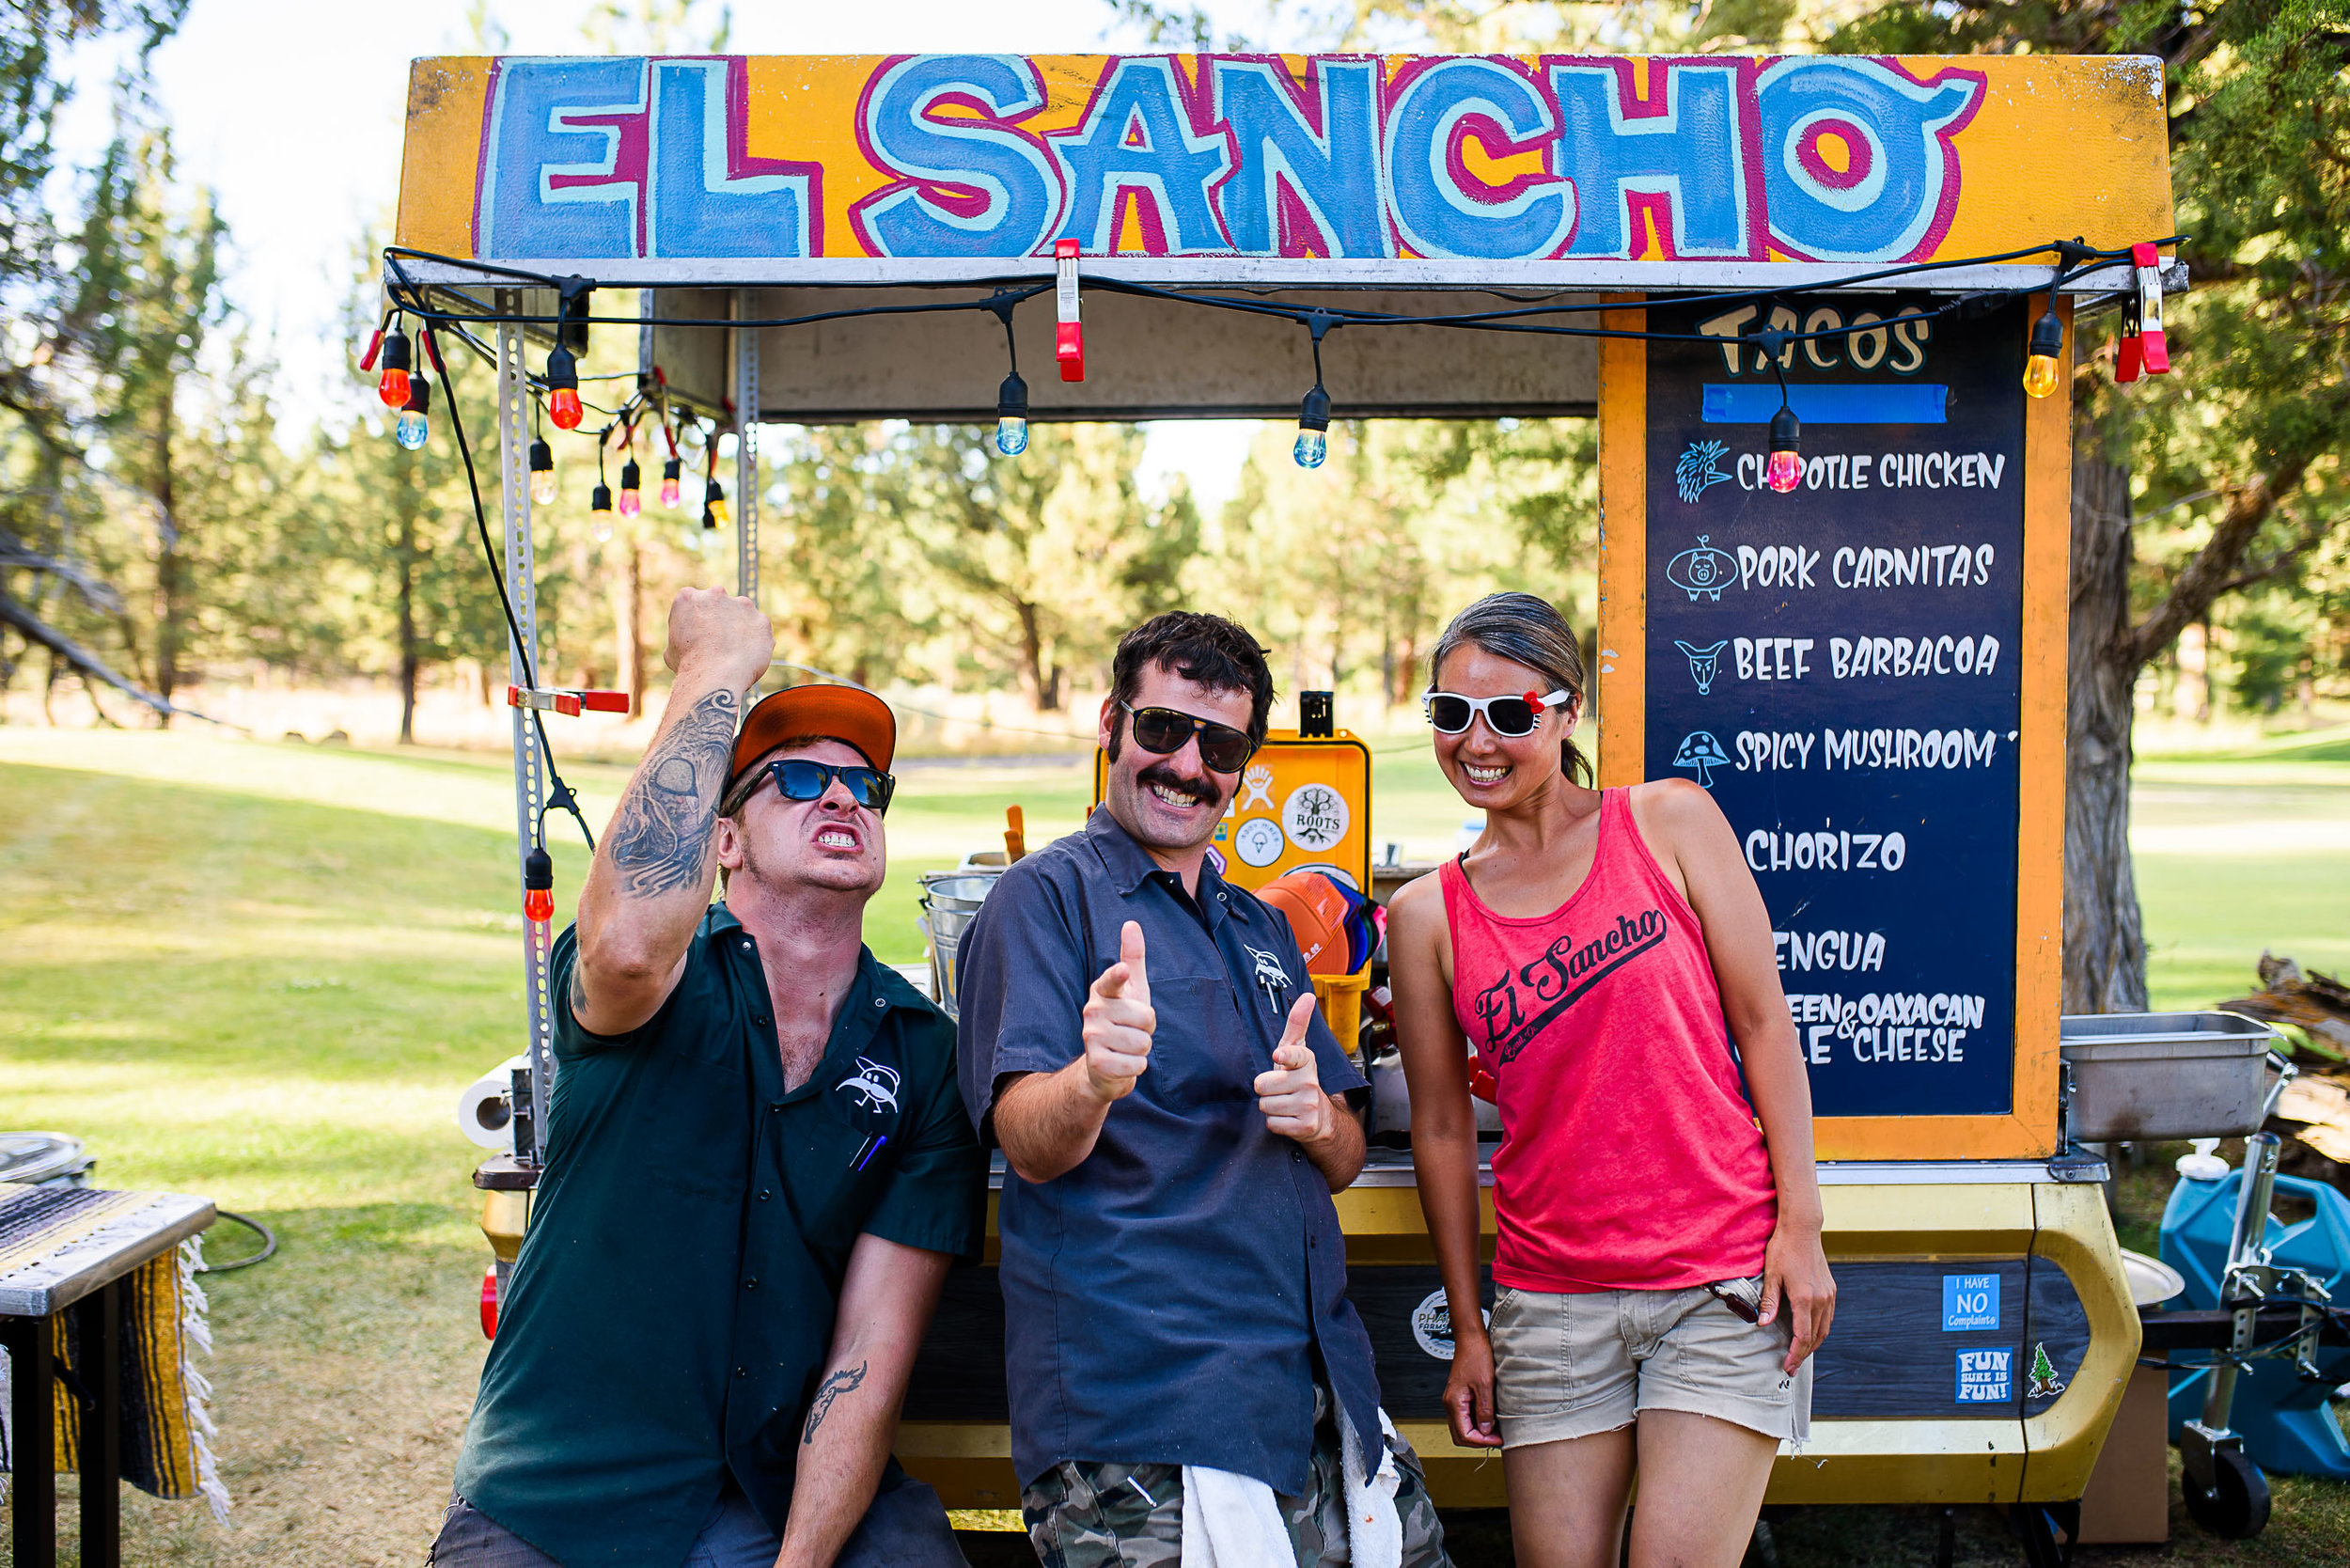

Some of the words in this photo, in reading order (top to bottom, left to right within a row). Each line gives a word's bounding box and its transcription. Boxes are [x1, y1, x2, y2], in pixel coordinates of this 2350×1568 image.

[474, 55, 823, 259] EL
[848, 54, 1987, 262] SANCHO
[1699, 303, 1930, 374] TACOS
[1736, 453, 1872, 491] CHOTLE
[1879, 451, 2006, 489] CHICKEN
[1737, 544, 1821, 590] PORK
[1832, 543, 1995, 588] CARNITAS
[1733, 636, 1814, 681] BEEF
[1829, 634, 2000, 679] BARBACOA
[1735, 730, 1815, 772] SPICY
[1825, 728, 1997, 770] MUSHROOM
[1296, 814, 1340, 830] ROOTS
[1746, 828, 1906, 871] CHORIZO
[1771, 930, 1887, 972] ENGUA
[1474, 969, 1526, 1053] El
[1520, 909, 1662, 1002] Sancho
[1784, 993, 1842, 1024] EEN
[1836, 1000, 1859, 1040] &
[1857, 992, 1985, 1029] OAXACAN
[1853, 1026, 1966, 1063] CHEESE
[1955, 1278, 1960, 1289] I
[1964, 1278, 1990, 1289] HAVE
[1956, 1293, 1989, 1314] NO
[1948, 1315, 1996, 1329] Complaints
[1958, 1351, 2011, 1372] FUN
[1961, 1372, 1993, 1383] SURE
[1995, 1372, 2008, 1382] IS
[1958, 1382, 2010, 1401] FUN!
